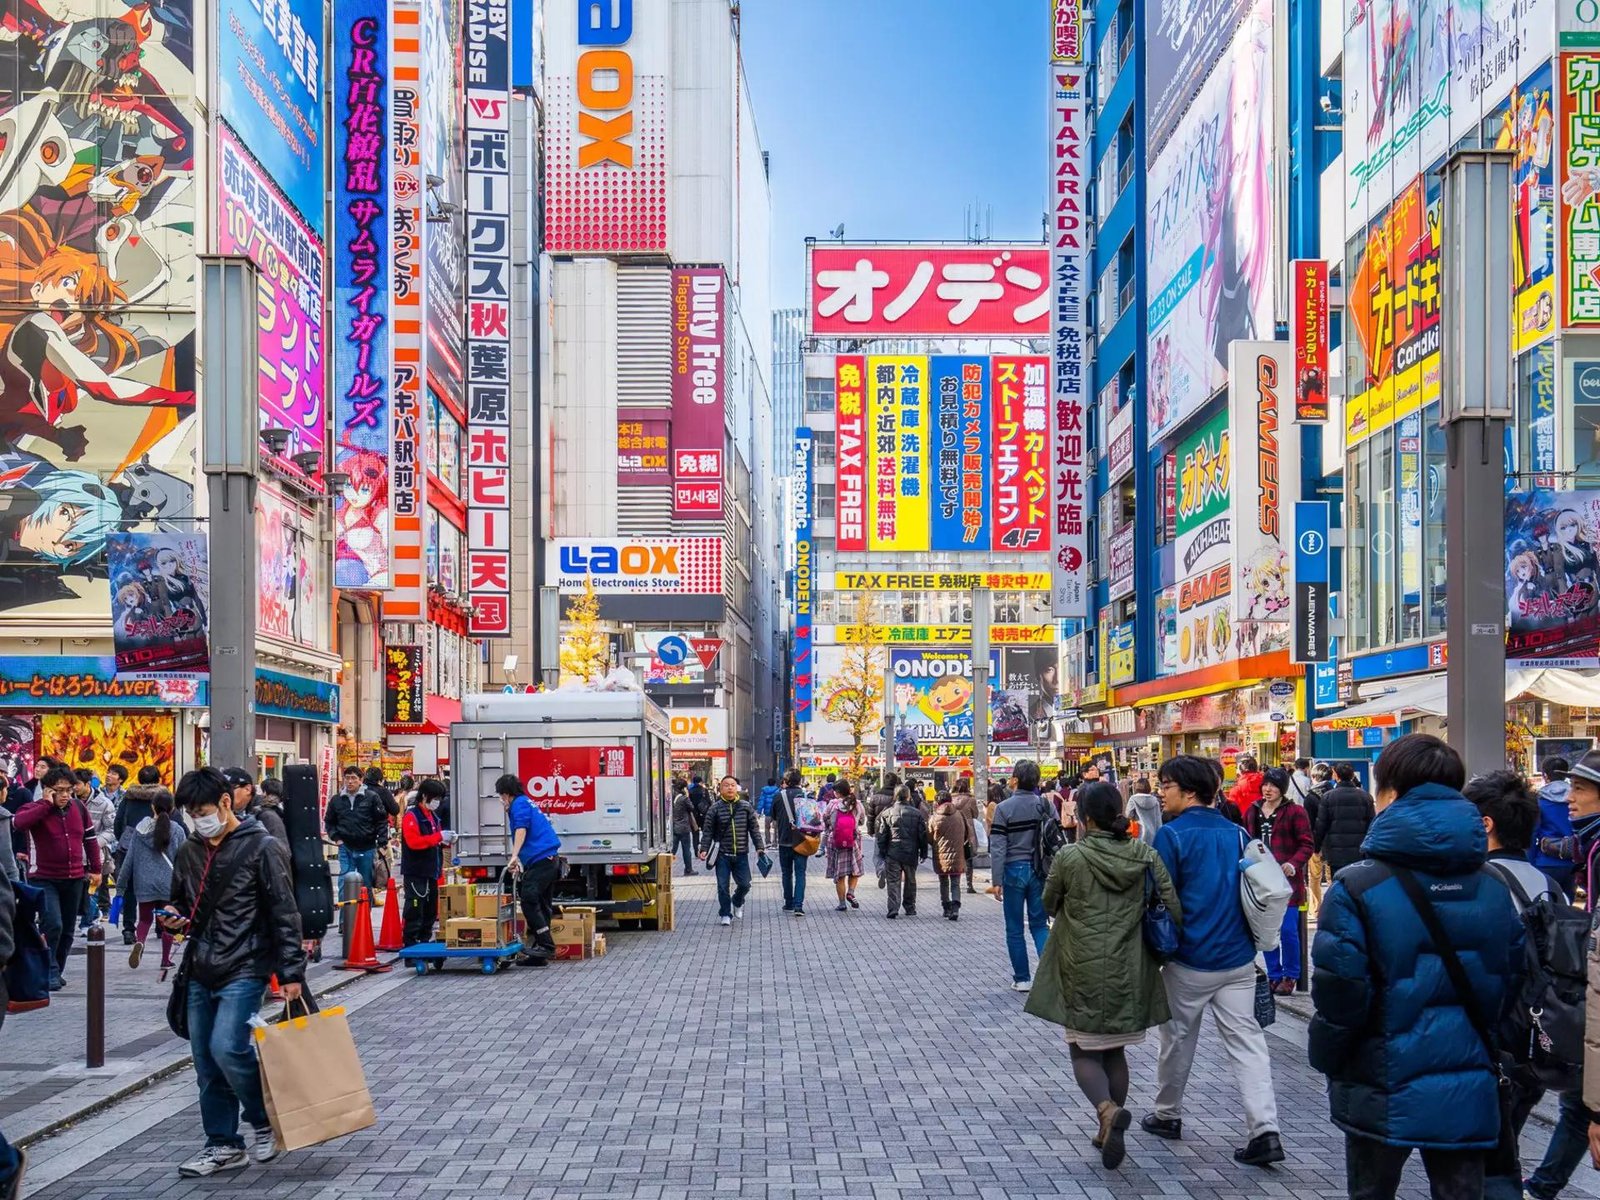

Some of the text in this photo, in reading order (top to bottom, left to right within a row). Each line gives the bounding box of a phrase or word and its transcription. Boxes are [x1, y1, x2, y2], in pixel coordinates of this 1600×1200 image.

[1056, 107, 1081, 248] TAKARADA
[224, 149, 322, 287] 赤坂見附駅前店
[347, 200, 382, 428] サムライガールズ
[675, 275, 690, 374] Flagship Store
[816, 251, 1050, 325] オノデン
[1372, 254, 1440, 378] カードキ
[690, 275, 721, 404] Duty Free
[1056, 326, 1082, 394] 免税商店
[394, 366, 414, 514] アキバ駅前店
[618, 423, 643, 436] 本店
[618, 436, 668, 449] 総合家電
[679, 454, 718, 473] 免税
[839, 364, 862, 540] 免税 TAX FREE
[900, 364, 920, 497] 冷蔵庫 洗濯機
[940, 377, 960, 518] お見積り無料です
[1257, 354, 1280, 541] GAMERS
[678, 489, 719, 504] 면세점
[1056, 399, 1083, 536] 歓迎光臨
[794, 438, 811, 615] Panasonic ONODEN
[1002, 528, 1039, 546] 4F
[592, 578, 649, 587] Electronics
[652, 578, 680, 587] Store
[845, 574, 882, 588] TAX
[886, 574, 935, 588] FREE
[938, 574, 982, 588] 免税店
[696, 644, 718, 652] 止まれ
[888, 627, 929, 640] 冷蔵庫
[935, 627, 972, 640] エアコ
[1308, 586, 1316, 651] ALIENWARE
[1008, 673, 1030, 681] 教えて
[607, 749, 625, 761] 100
